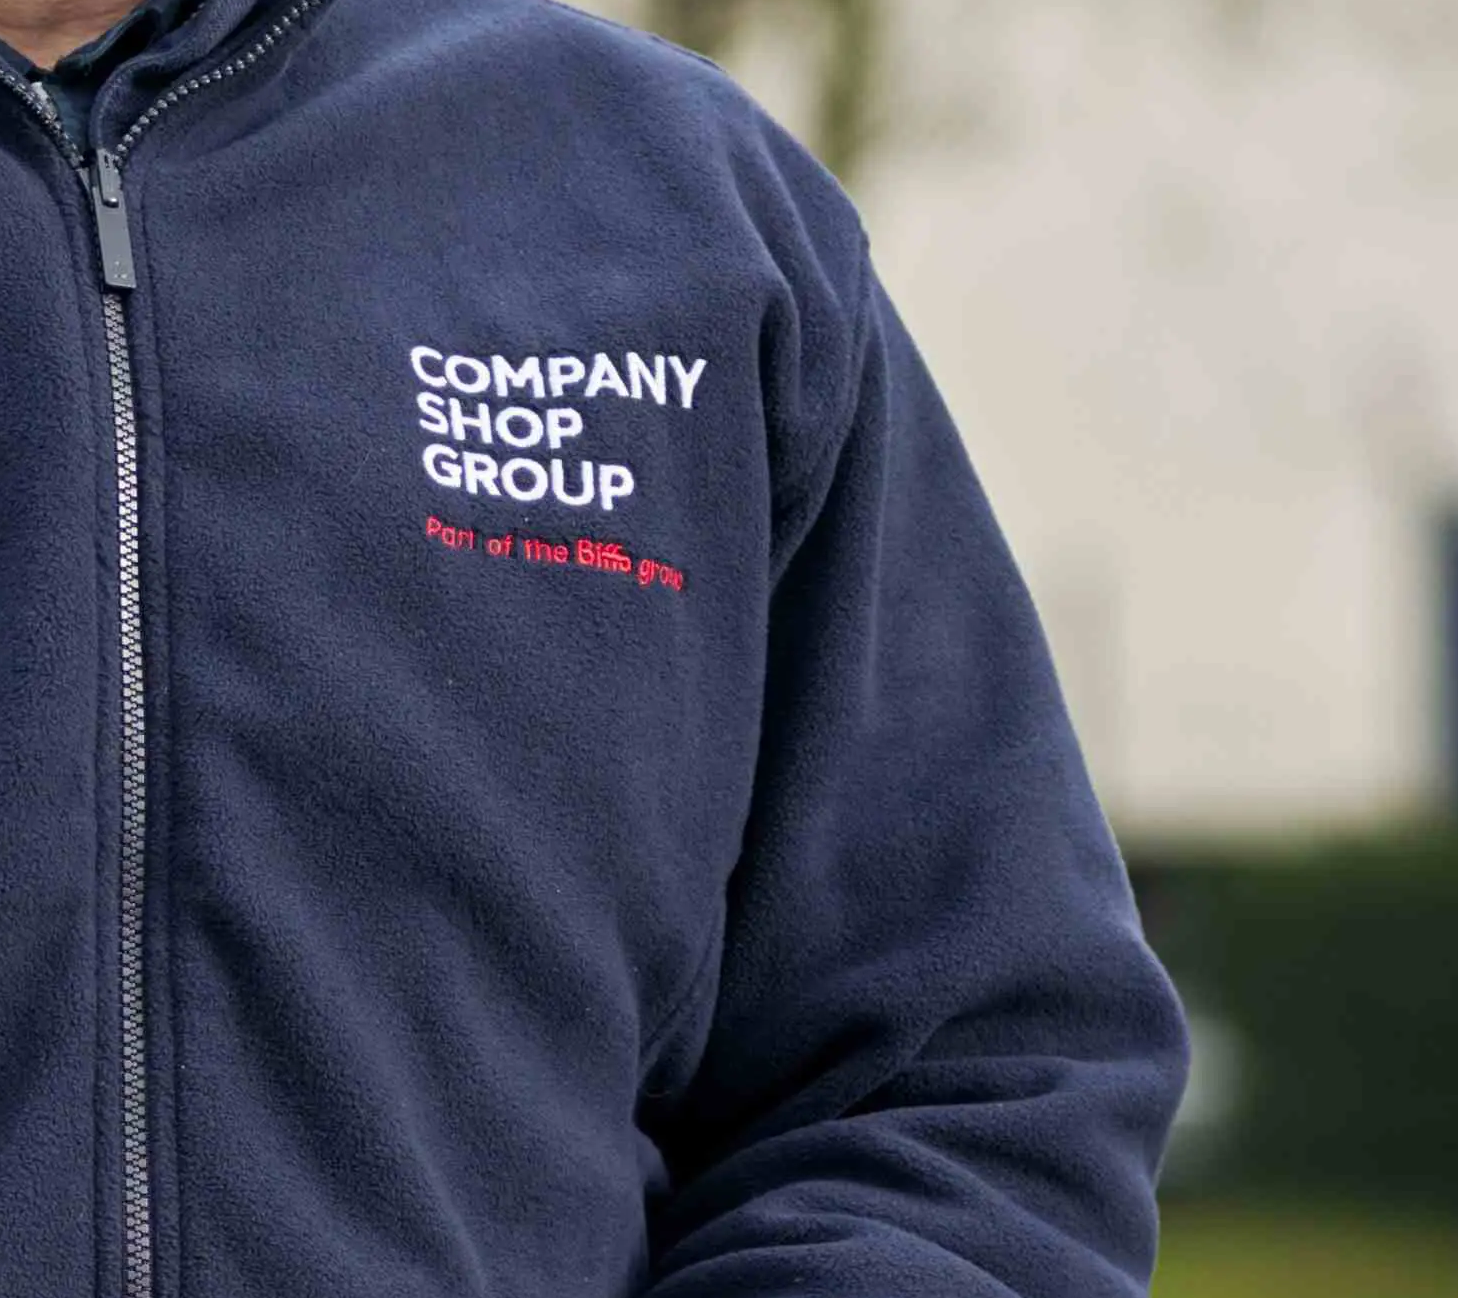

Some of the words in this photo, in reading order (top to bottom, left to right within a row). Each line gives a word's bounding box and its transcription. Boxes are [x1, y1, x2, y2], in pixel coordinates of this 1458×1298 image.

[410, 345, 707, 409] COMPANY
[416, 391, 584, 450] SHOP
[422, 443, 635, 511] GROUP
[425, 515, 475, 550] Part
[486, 533, 514, 558] of
[522, 538, 570, 564] the
[636, 558, 684, 592] group
